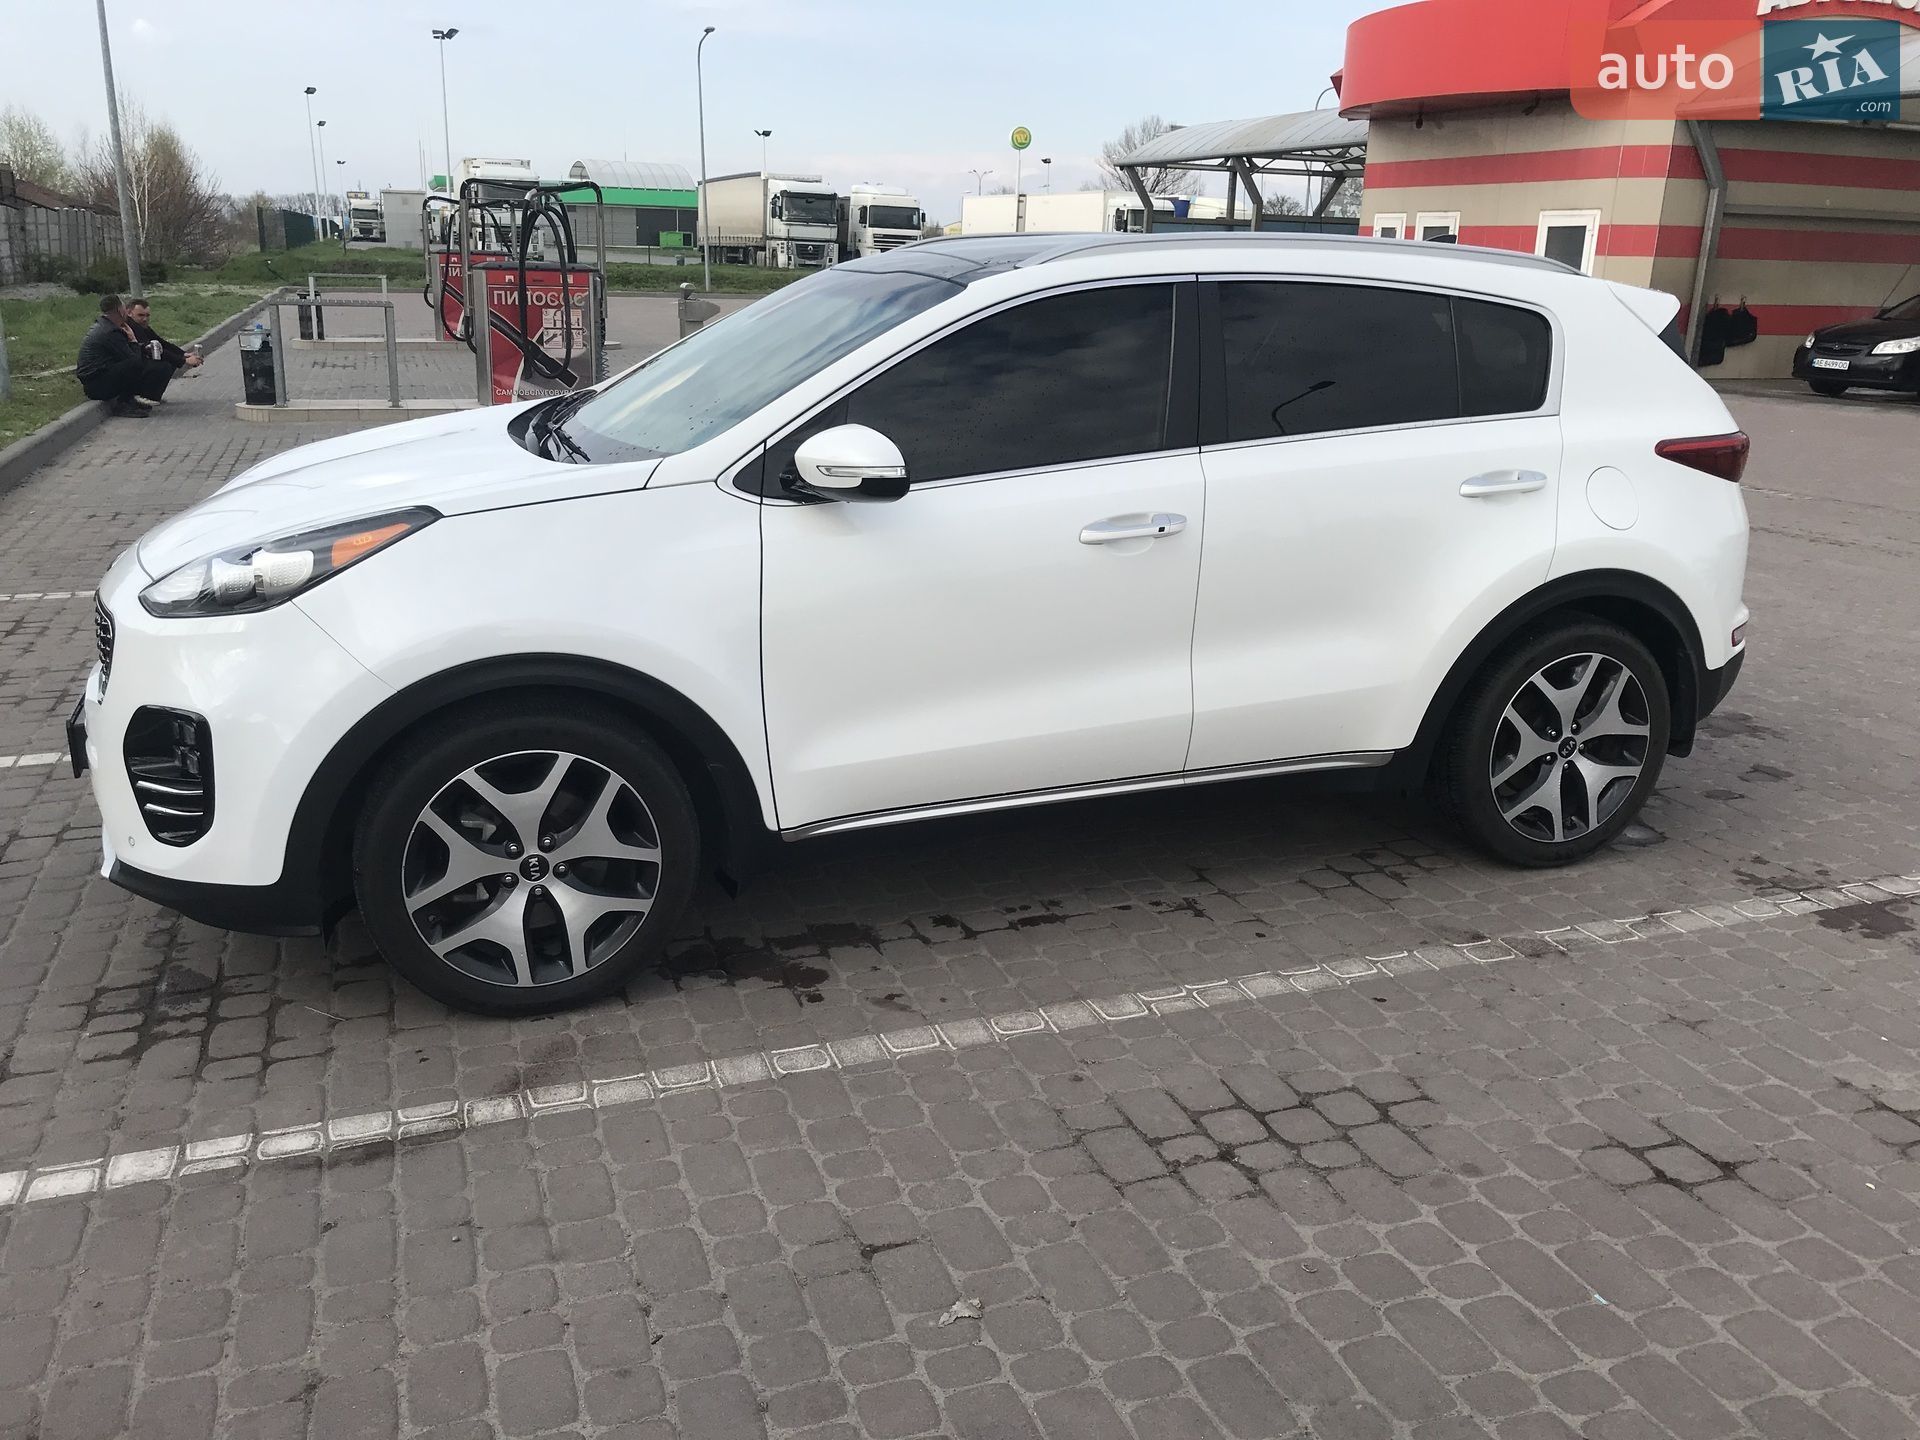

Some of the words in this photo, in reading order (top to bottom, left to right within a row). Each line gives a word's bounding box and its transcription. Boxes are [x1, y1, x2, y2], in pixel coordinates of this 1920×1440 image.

[495, 389, 576, 397] САМООБСЛУГОВУВА
[1561, 740, 1576, 756] KIA
[528, 857, 541, 880] KIA
